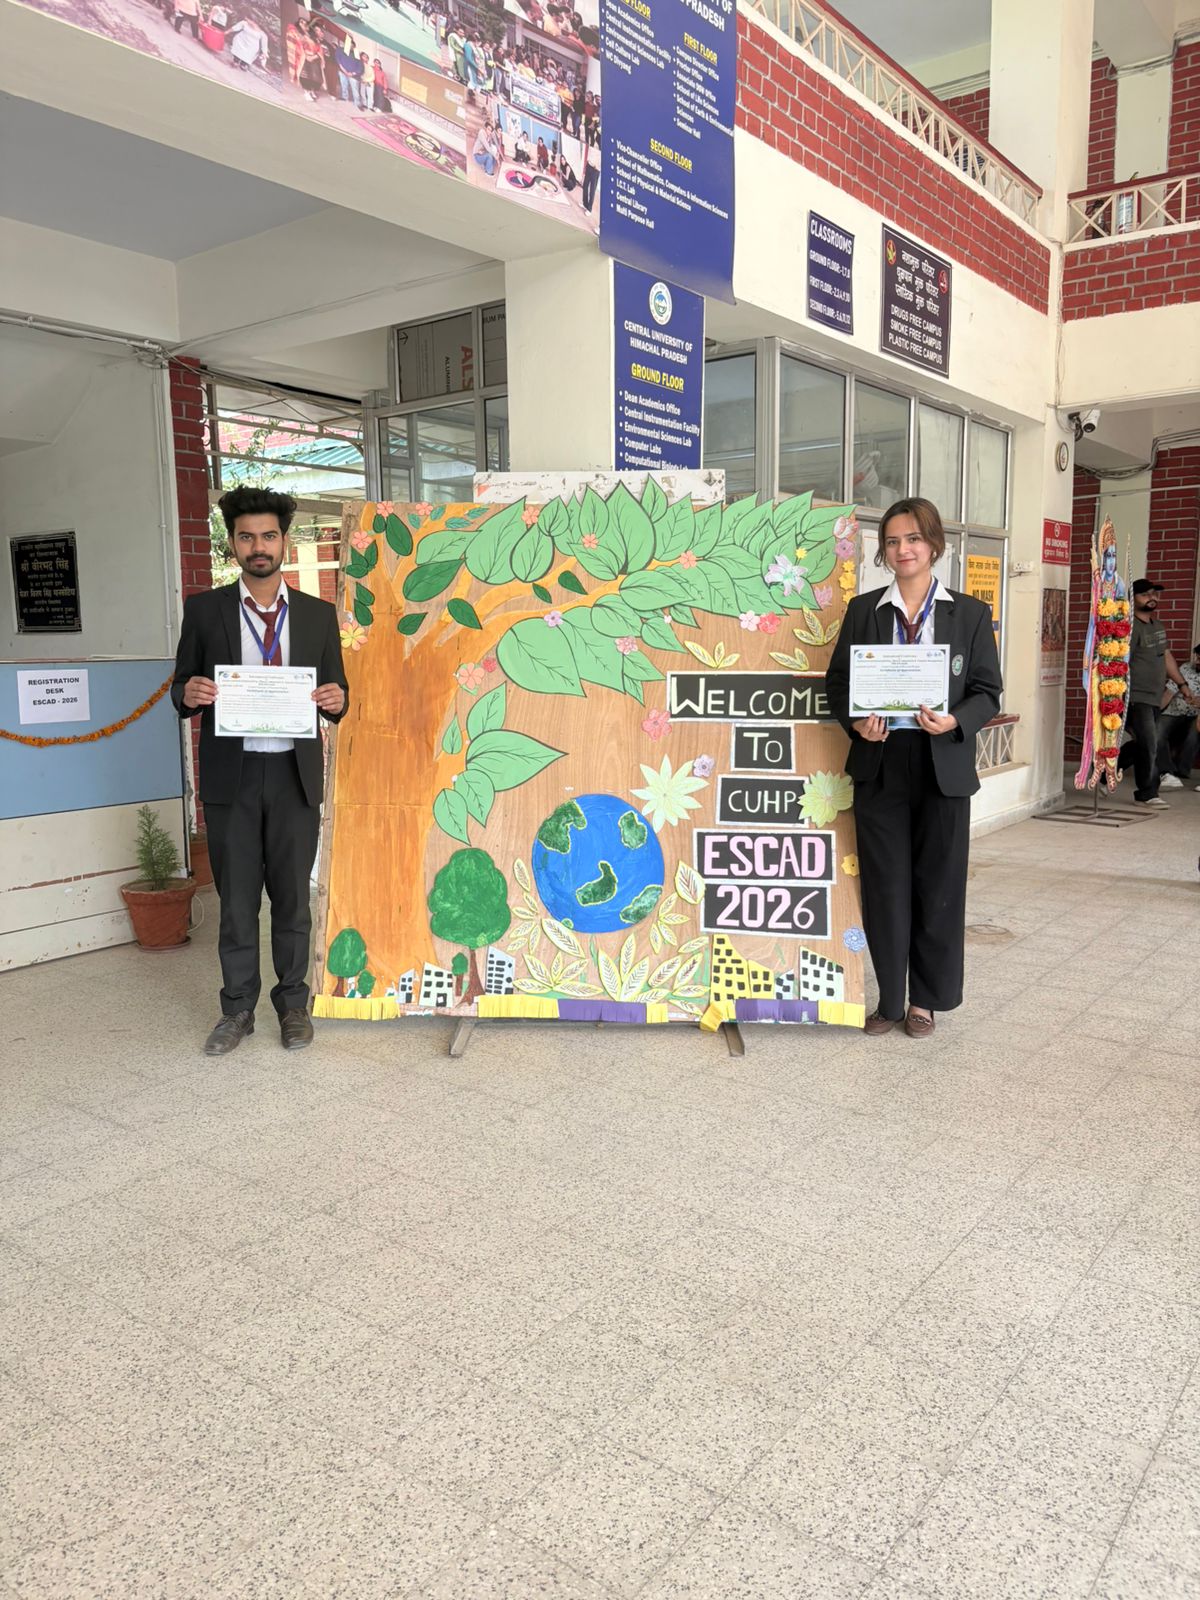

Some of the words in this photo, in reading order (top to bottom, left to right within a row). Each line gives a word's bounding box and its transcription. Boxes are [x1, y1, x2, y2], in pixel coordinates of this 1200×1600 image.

[606, 10, 621, 28] Central
[642, 23, 654, 38] Office
[637, 44, 656, 65] Sciences
[684, 32, 699, 51] FIRST
[700, 43, 717, 65] FLOOR
[632, 53, 640, 66] Lab
[692, 68, 703, 82] Office
[708, 68, 719, 82] Office
[677, 82, 690, 97] School
[705, 89, 716, 103] Office
[677, 94, 690, 109] School
[617, 152, 631, 168] School
[632, 162, 637, 171] of
[650, 138, 673, 160] SECOND
[674, 151, 692, 170] FLOOR
[617, 165, 631, 181] School
[632, 174, 637, 184] of
[650, 158, 663, 173] Office
[628, 183, 636, 196] Lab
[616, 190, 632, 206] Central
[633, 199, 648, 216] Library
[810, 219, 852, 255] CLASSROOMS
[809, 249, 827, 267] GROUND
[809, 275, 820, 290] FIRST
[890, 304, 908, 322] DRUGS
[909, 313, 922, 329] FREE
[922, 320, 942, 337] CAMPUS
[624, 320, 651, 339] CENTRAL
[651, 329, 684, 350] UNIVERSITY
[684, 342, 693, 353] OF
[890, 319, 908, 336] SMOKE
[909, 327, 922, 342] FREE
[922, 333, 942, 351] CAMPUS
[630, 337, 660, 357] HIMACHAL
[661, 347, 688, 365] PRADESH
[888, 333, 909, 351] PLASTIC
[909, 342, 922, 356] FREE
[922, 348, 942, 365] CAMPUS
[631, 362, 661, 384] GROUND
[662, 372, 684, 390] FLOOR
[624, 390, 638, 404] Dean
[638, 395, 665, 412] Academics
[666, 402, 681, 416] Office
[624, 406, 643, 420] Central
[643, 411, 682, 431] Instrumentation
[683, 421, 700, 437] Facility
[624, 421, 660, 440] Environmental
[660, 431, 682, 445] Sciences
[682, 436, 692, 448] Lab
[624, 436, 649, 452] Computer
[649, 443, 662, 455] Labs
[624, 452, 661, 469] Computational
[28, 677, 80, 686] REGISTRATION
[671, 676, 831, 717] WELCOME
[728, 789, 798, 814] CUHP
[704, 835, 826, 879] ESCAD
[716, 884, 819, 930] 2026
